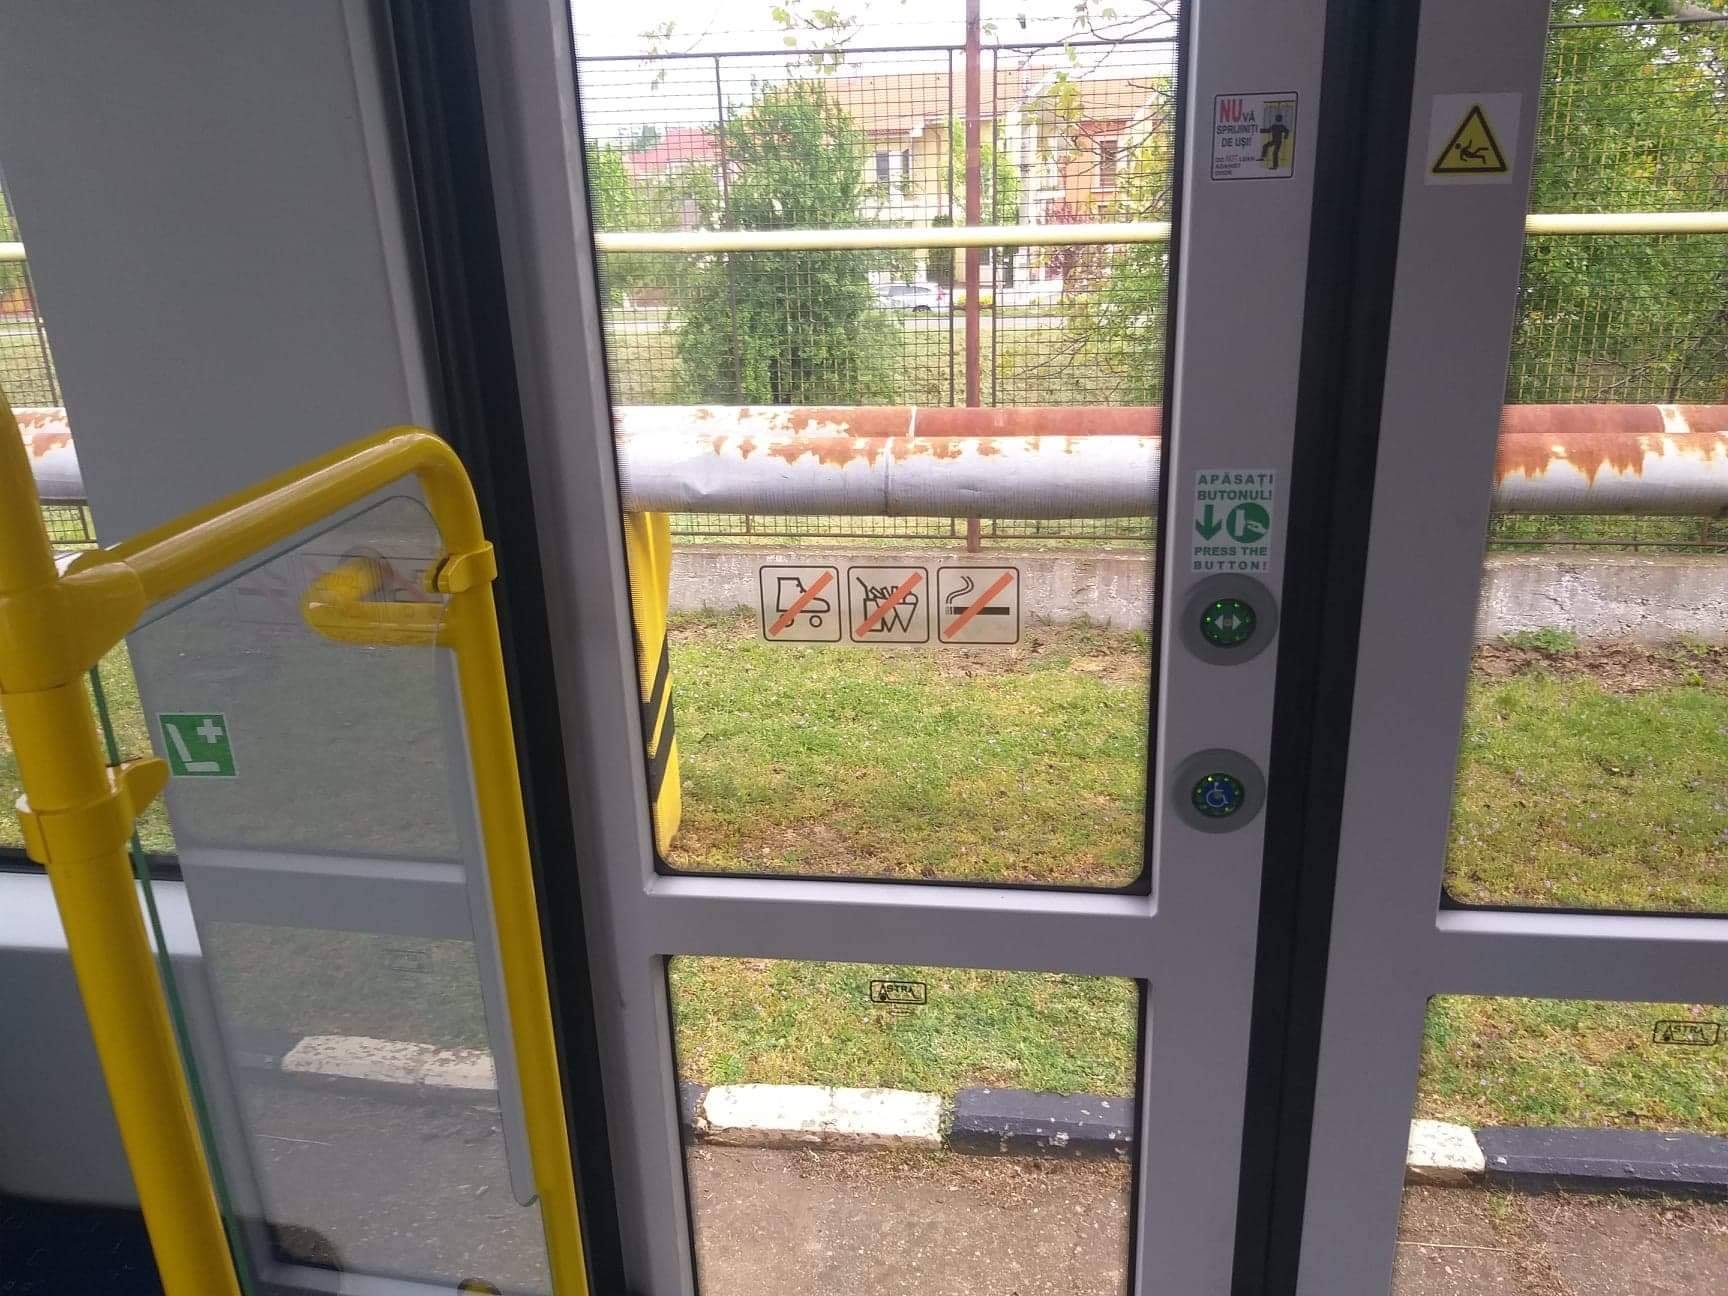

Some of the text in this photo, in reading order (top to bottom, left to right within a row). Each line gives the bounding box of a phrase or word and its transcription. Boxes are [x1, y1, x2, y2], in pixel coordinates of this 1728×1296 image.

[1219, 99, 1242, 123] NU
[1221, 137, 1233, 147] DE
[1197, 489, 1272, 500] BUTONUL!
[1194, 546, 1268, 556] PRESS THE
[1193, 560, 1267, 570] BUTTON!
[878, 983, 919, 1000] ASTRA
[1662, 1024, 1705, 1040] ASTRA
